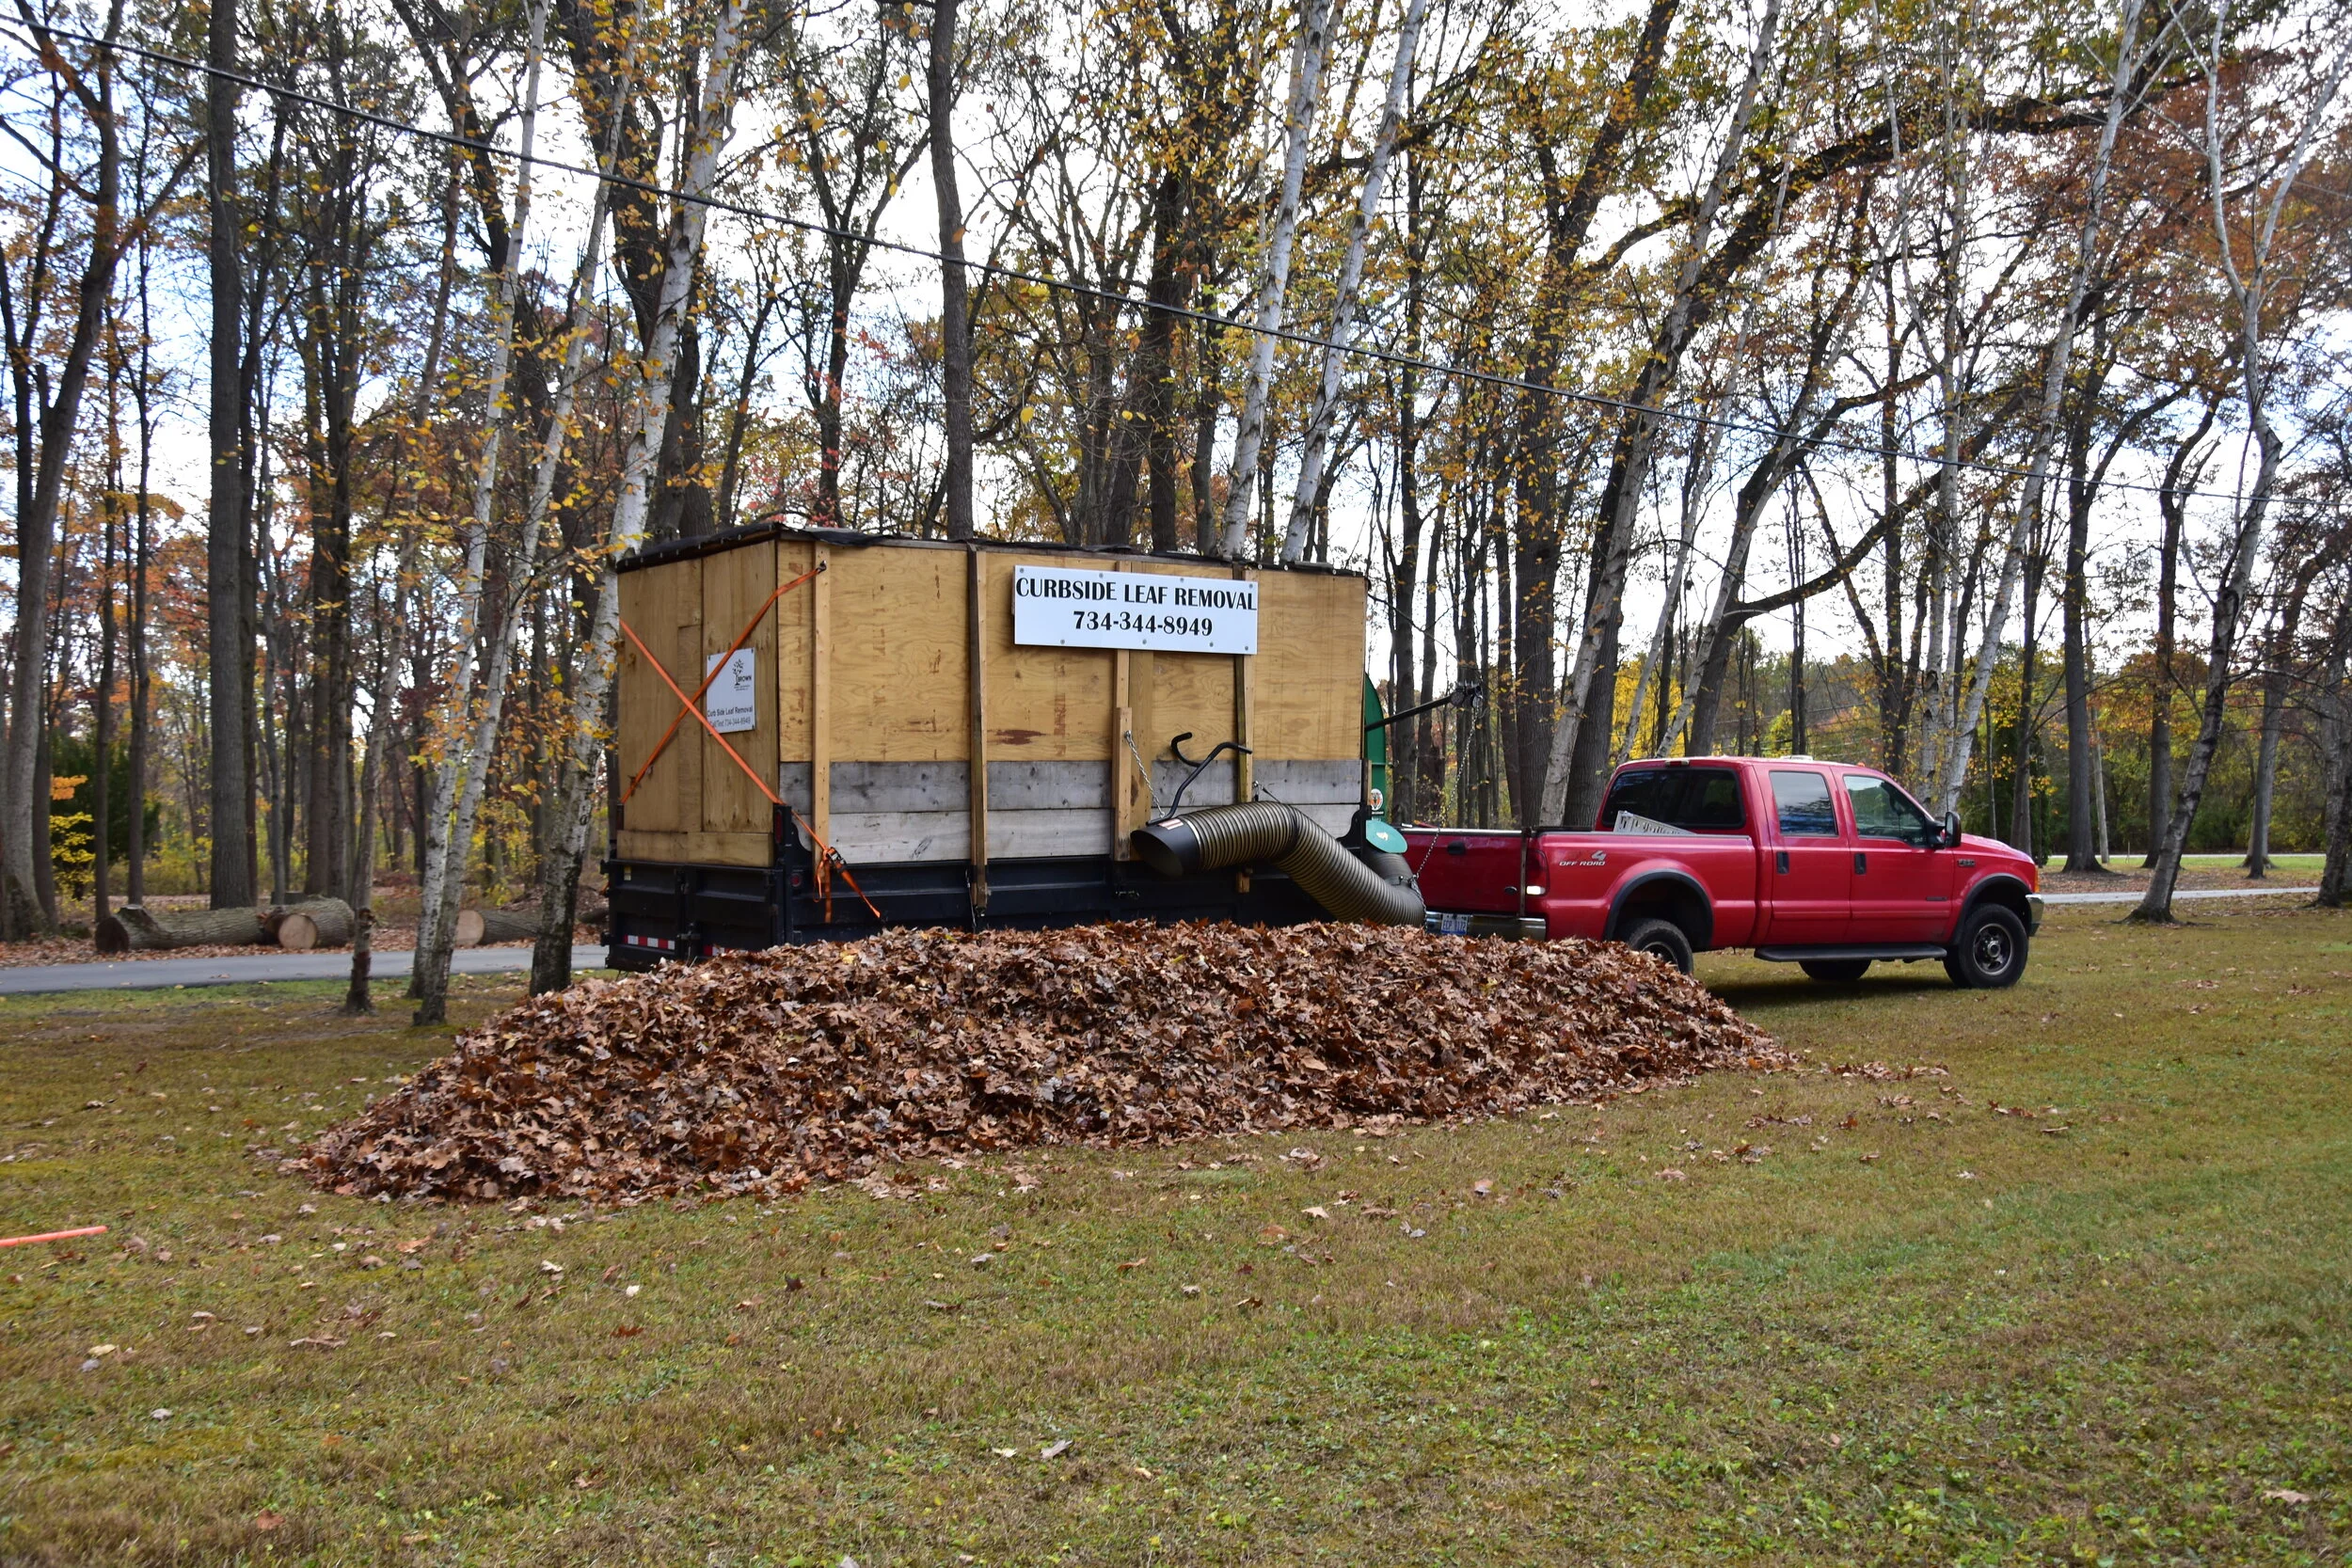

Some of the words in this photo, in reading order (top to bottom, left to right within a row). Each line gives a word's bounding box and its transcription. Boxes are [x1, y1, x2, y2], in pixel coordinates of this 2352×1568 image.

[1016, 578, 1117, 601] CURBSIDE
[1124, 584, 1168, 605] LEAF
[1175, 588, 1257, 610] REMOVAL
[1073, 610, 1213, 636] 734-344-8949
[725, 706, 734, 715] Leaf
